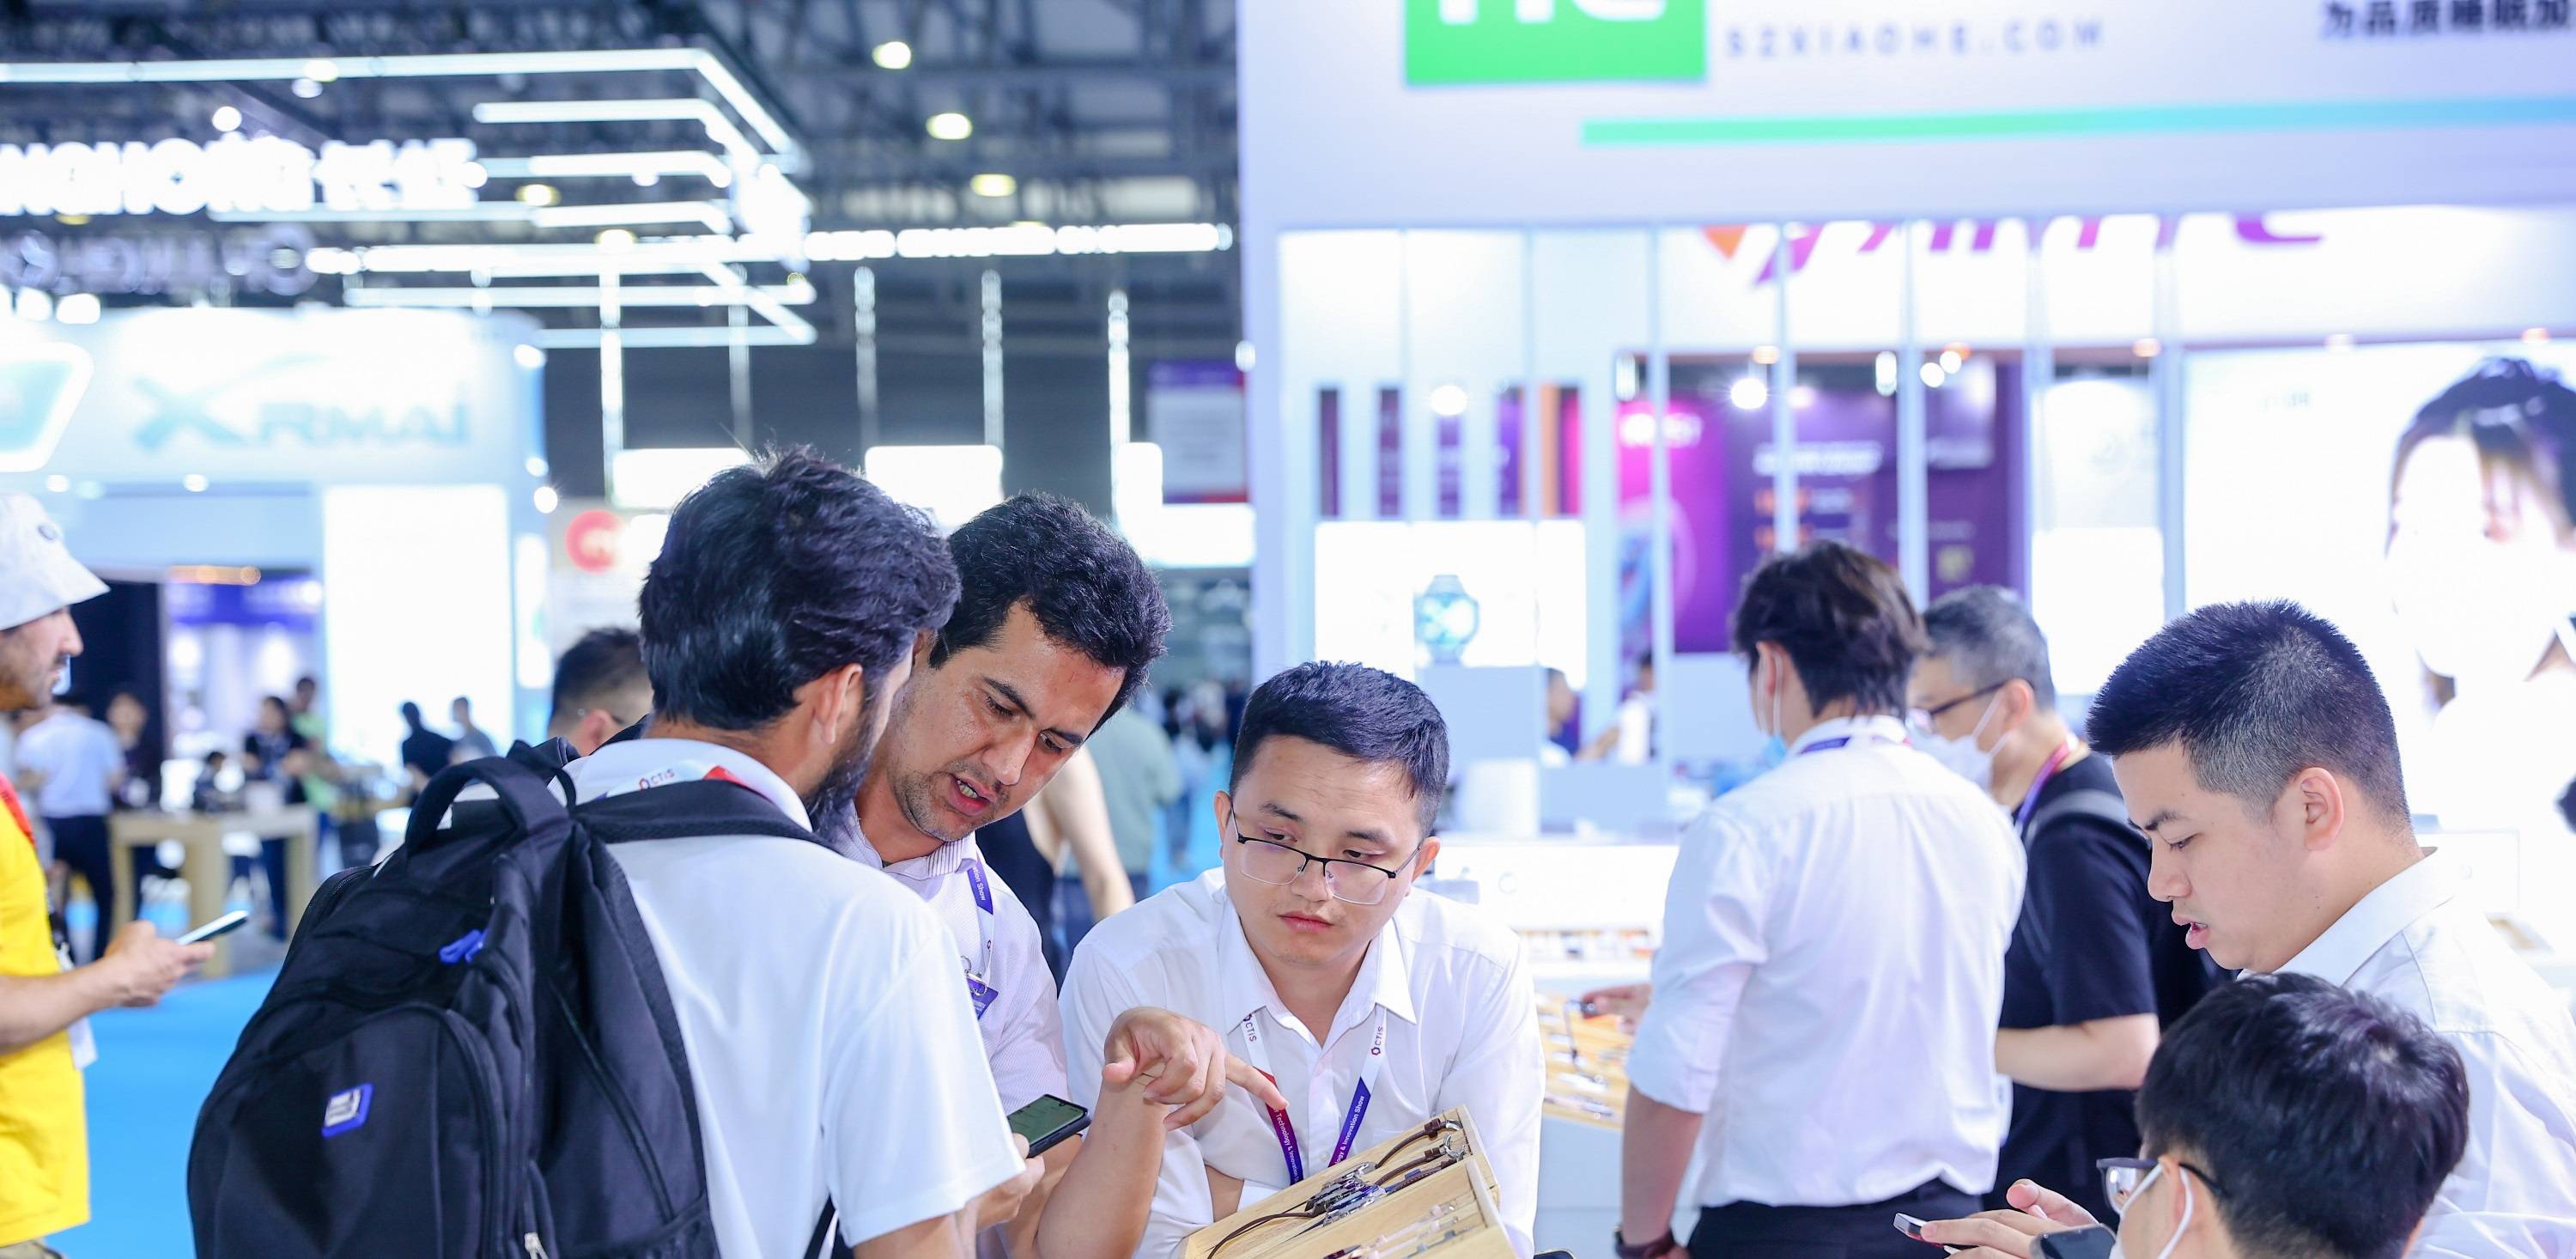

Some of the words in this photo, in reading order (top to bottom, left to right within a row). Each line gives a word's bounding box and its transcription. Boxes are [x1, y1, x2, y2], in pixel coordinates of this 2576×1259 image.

[976, 882, 987, 901] Show
[1276, 1113, 1291, 1146] Technology
[1342, 1114, 1359, 1145] Innovation
[1354, 1095, 1365, 1114] Show
